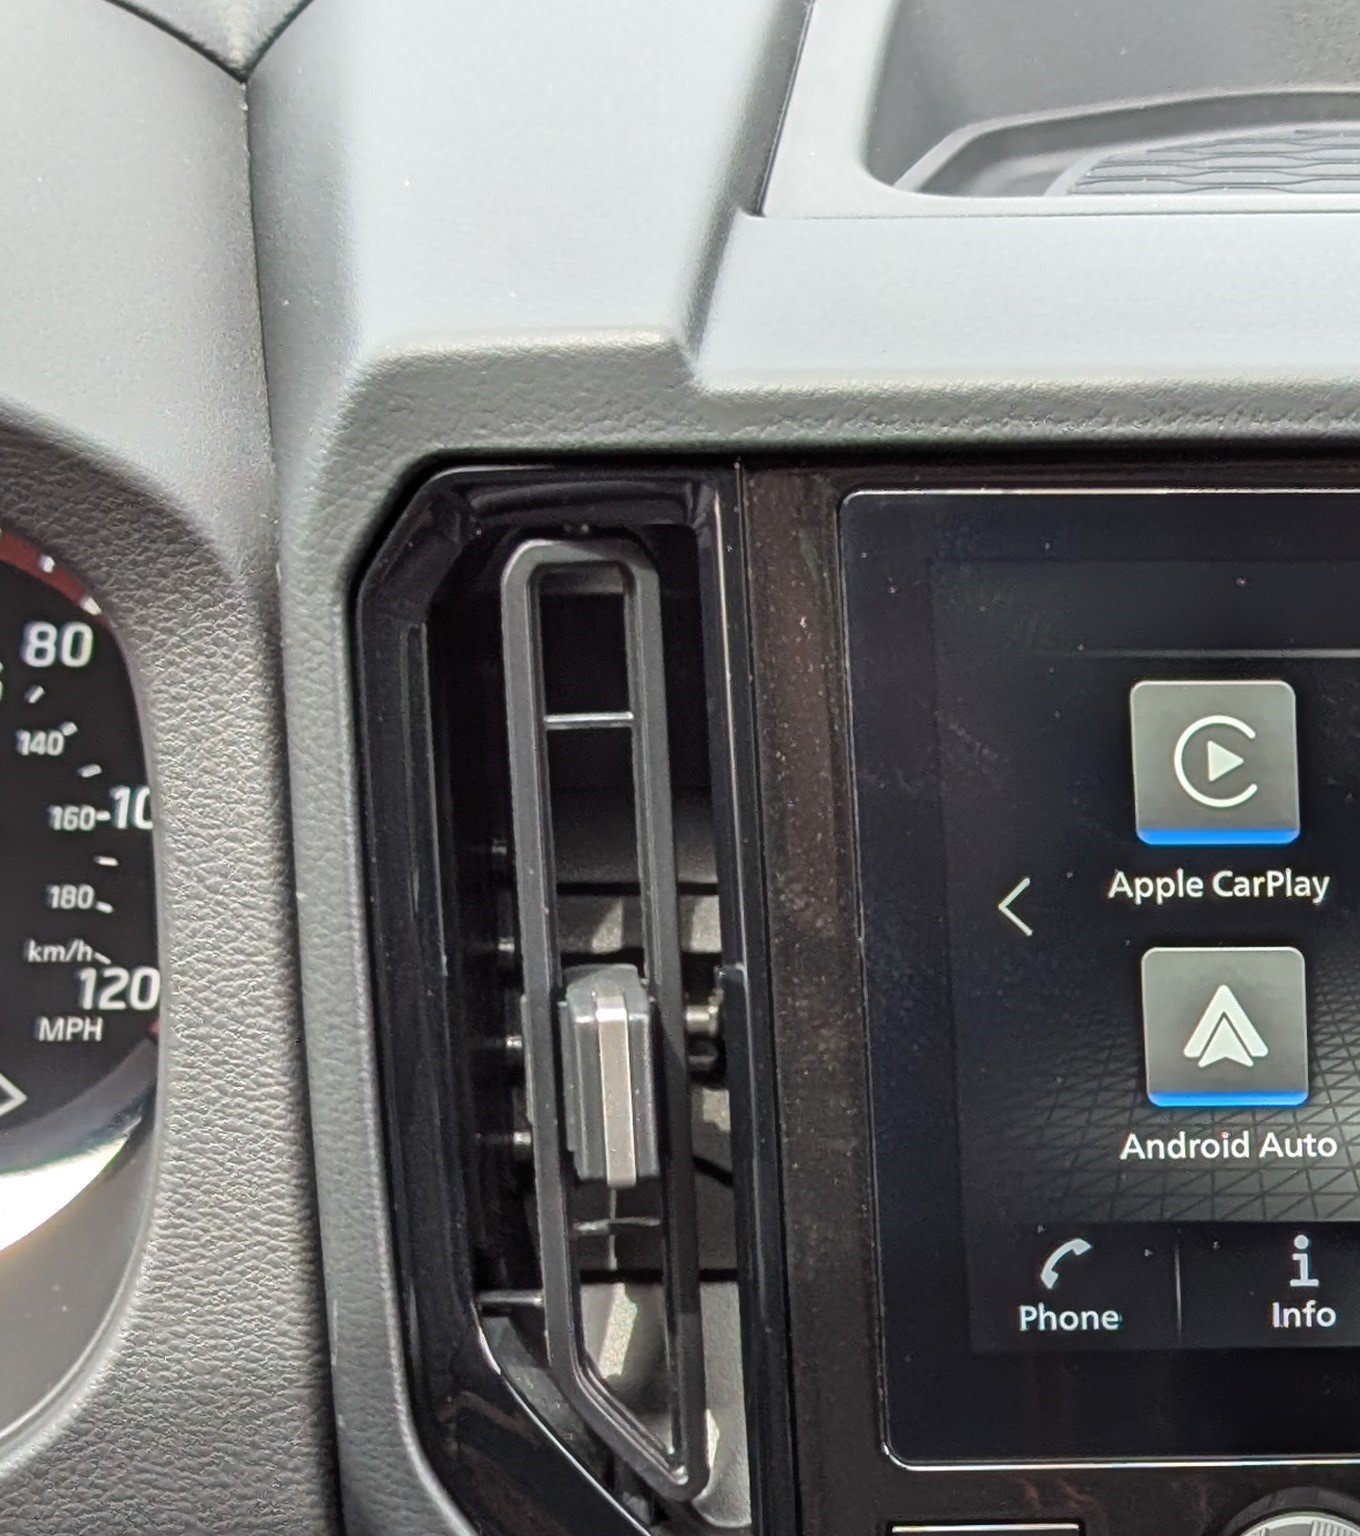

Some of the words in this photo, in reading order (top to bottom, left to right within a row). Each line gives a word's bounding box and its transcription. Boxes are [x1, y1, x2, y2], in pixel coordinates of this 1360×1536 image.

[22, 621, 93, 668] 80
[16, 729, 64, 756] 140
[48, 806, 96, 831] 160
[46, 885, 95, 910] 180
[1108, 872, 1204, 904] Apple
[1212, 870, 1331, 903] CarPlay
[27, 941, 92, 964] km/h
[77, 968, 160, 1010] 120
[34, 1017, 103, 1042] MPH
[1120, 1132, 1252, 1162] Android
[1260, 1132, 1338, 1161] Auto
[1019, 1304, 1121, 1332] Phone
[1272, 1302, 1337, 1330] Info
